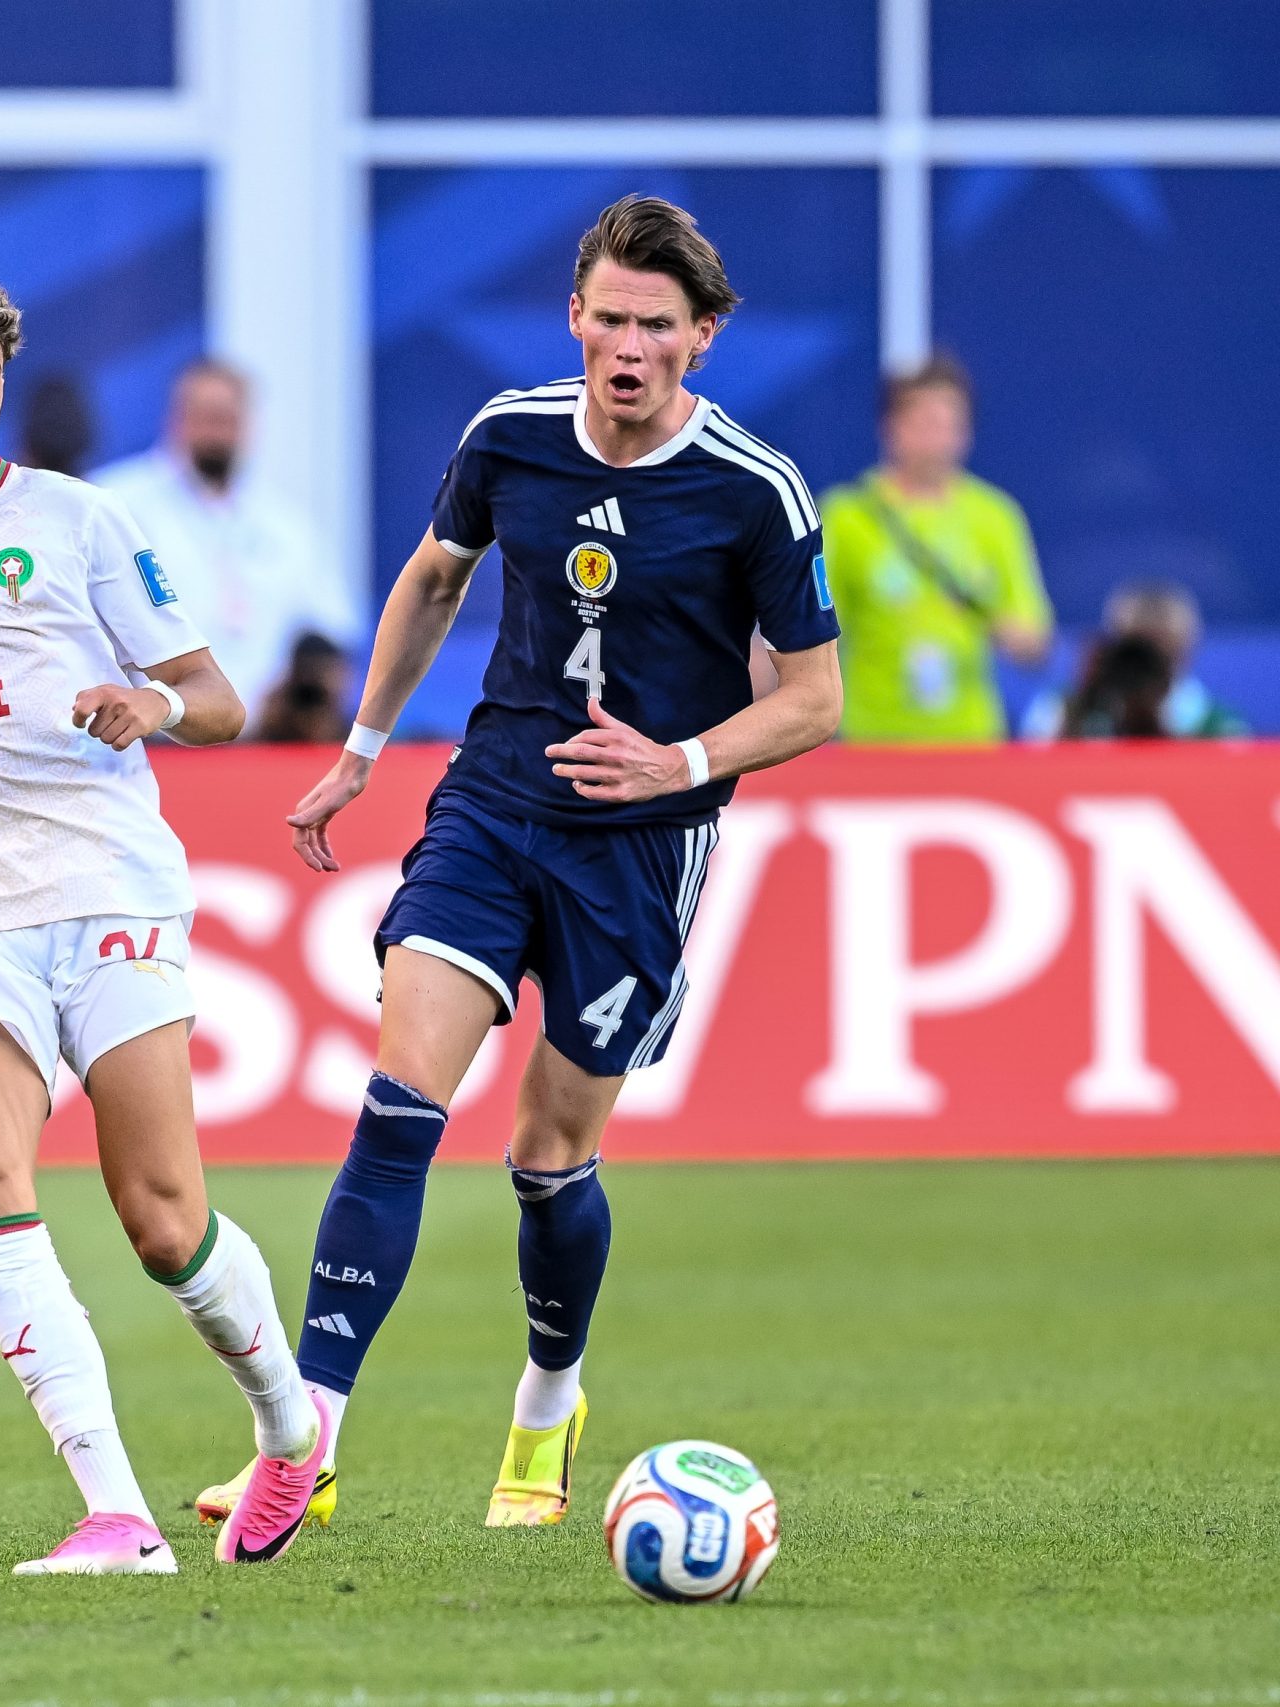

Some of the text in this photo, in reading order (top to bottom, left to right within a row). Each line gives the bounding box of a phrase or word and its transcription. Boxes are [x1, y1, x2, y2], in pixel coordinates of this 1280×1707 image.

[582, 543, 608, 554] SCOTLAND
[577, 608, 600, 619] BOSTON
[578, 601, 593, 610] JUNE
[563, 627, 606, 701] 4
[579, 975, 638, 1050] 4
[314, 1260, 376, 1287] ALBA
